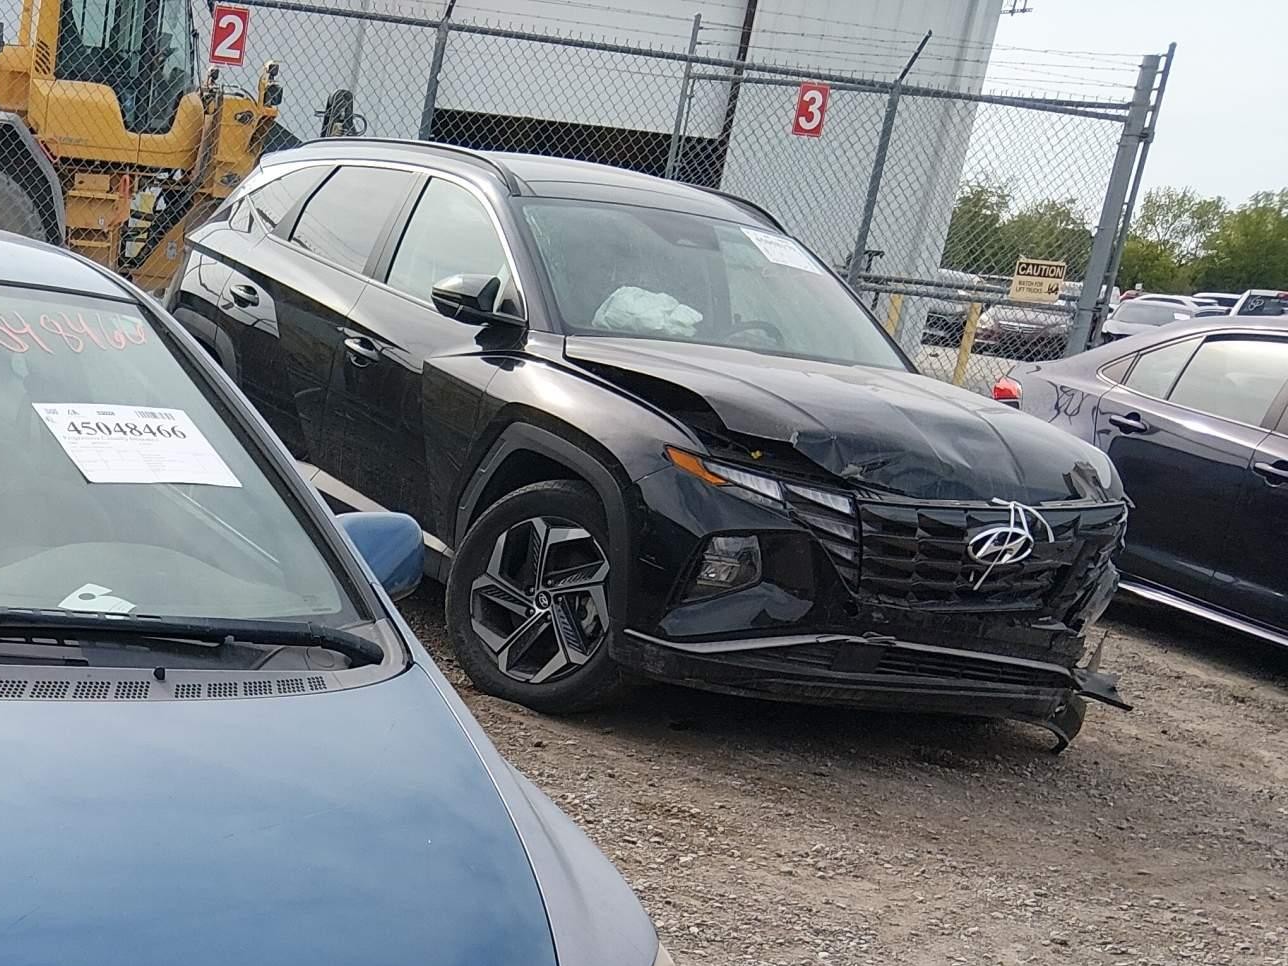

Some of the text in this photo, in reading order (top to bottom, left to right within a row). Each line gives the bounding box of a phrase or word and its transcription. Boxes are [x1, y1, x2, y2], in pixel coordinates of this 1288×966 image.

[214, 14, 244, 59] 2
[798, 90, 823, 130] 3
[1018, 263, 1063, 277] CAUTION
[66, 421, 187, 440] 45048466
